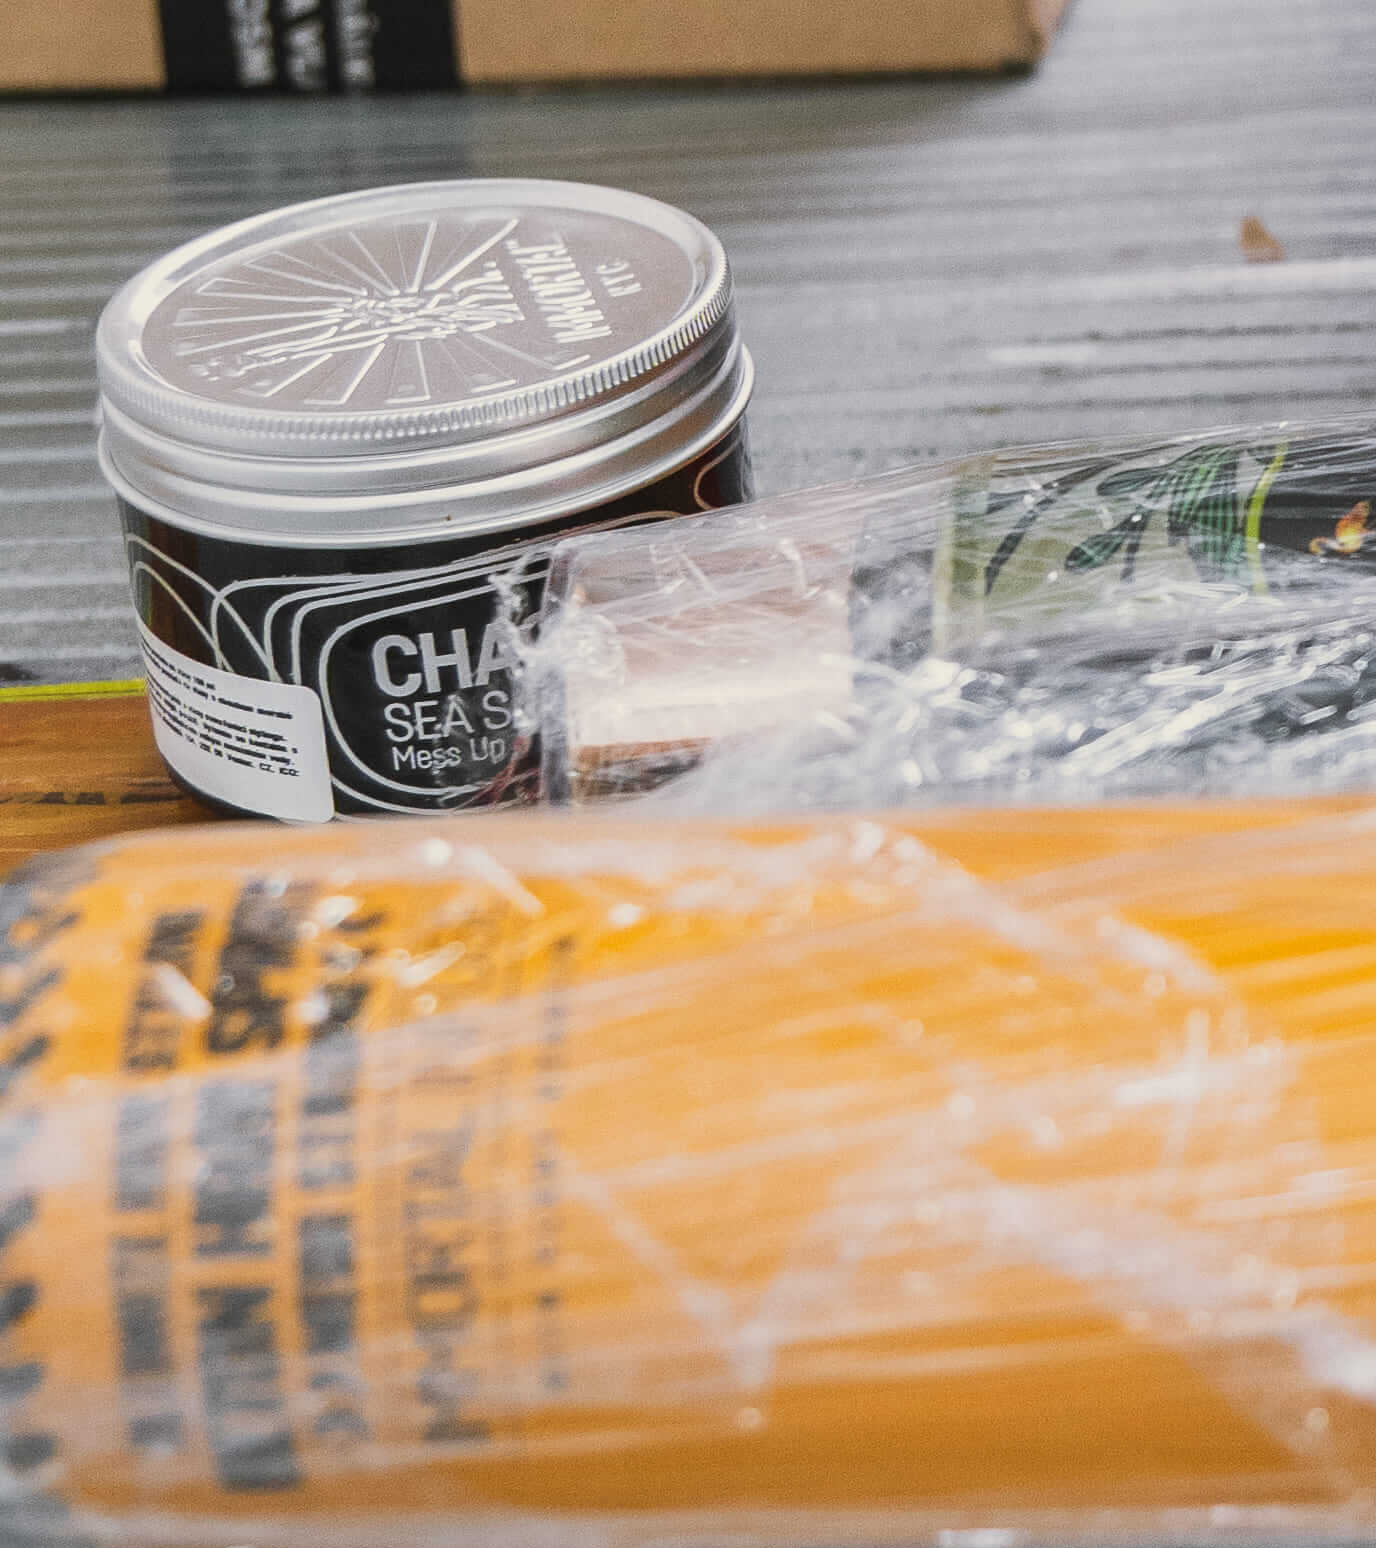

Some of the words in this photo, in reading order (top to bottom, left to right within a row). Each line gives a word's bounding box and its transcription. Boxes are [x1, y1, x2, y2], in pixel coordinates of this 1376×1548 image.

[383, 694, 475, 743] SEA
[392, 744, 462, 771] Mess
[468, 737, 506, 765] Up
